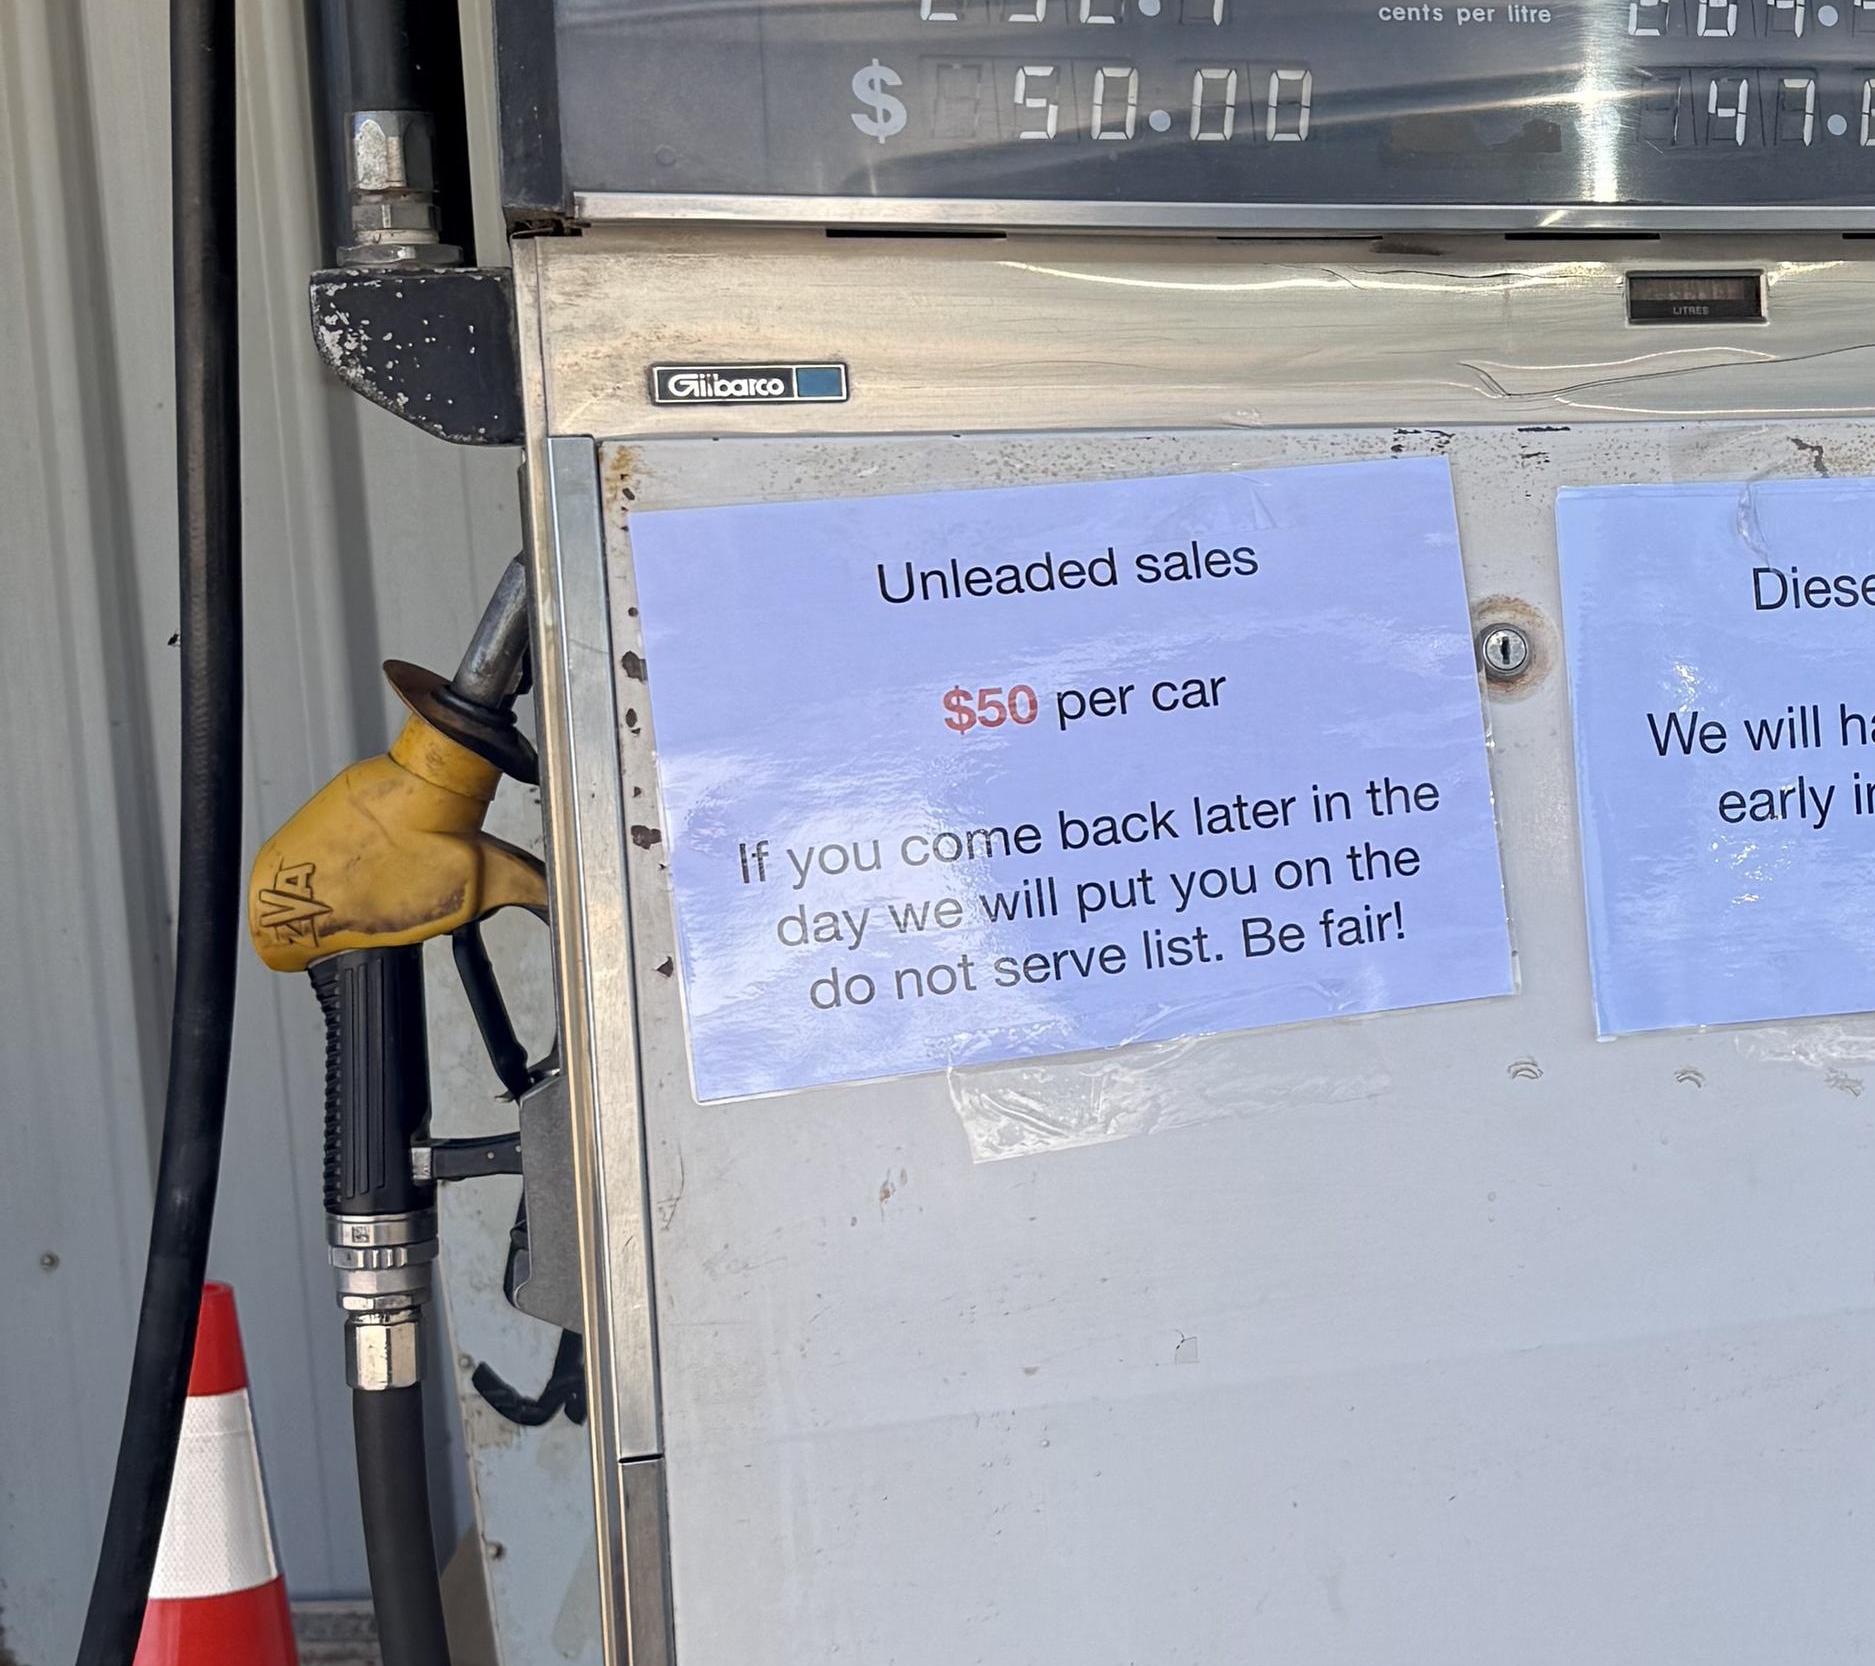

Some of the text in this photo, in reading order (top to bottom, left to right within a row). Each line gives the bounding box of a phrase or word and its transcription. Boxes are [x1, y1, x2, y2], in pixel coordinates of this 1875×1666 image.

[1379, 4, 1550, 25] cents per litre
[852, 59, 1312, 144] $ 50.00
[1673, 306, 1709, 315] LITRES
[668, 373, 785, 398] Gilbarco
[877, 541, 1258, 603] Unleaded sales
[943, 677, 1226, 734] $50 per car
[1647, 711, 1727, 756] We
[1744, 705, 1821, 751] will
[1719, 776, 1835, 829] early
[739, 777, 1439, 890] If you come back later in the
[257, 861, 333, 949] ZVA
[778, 842, 1420, 950] day we will put you on the
[810, 901, 1405, 1009] do not serve list. Be fair!
